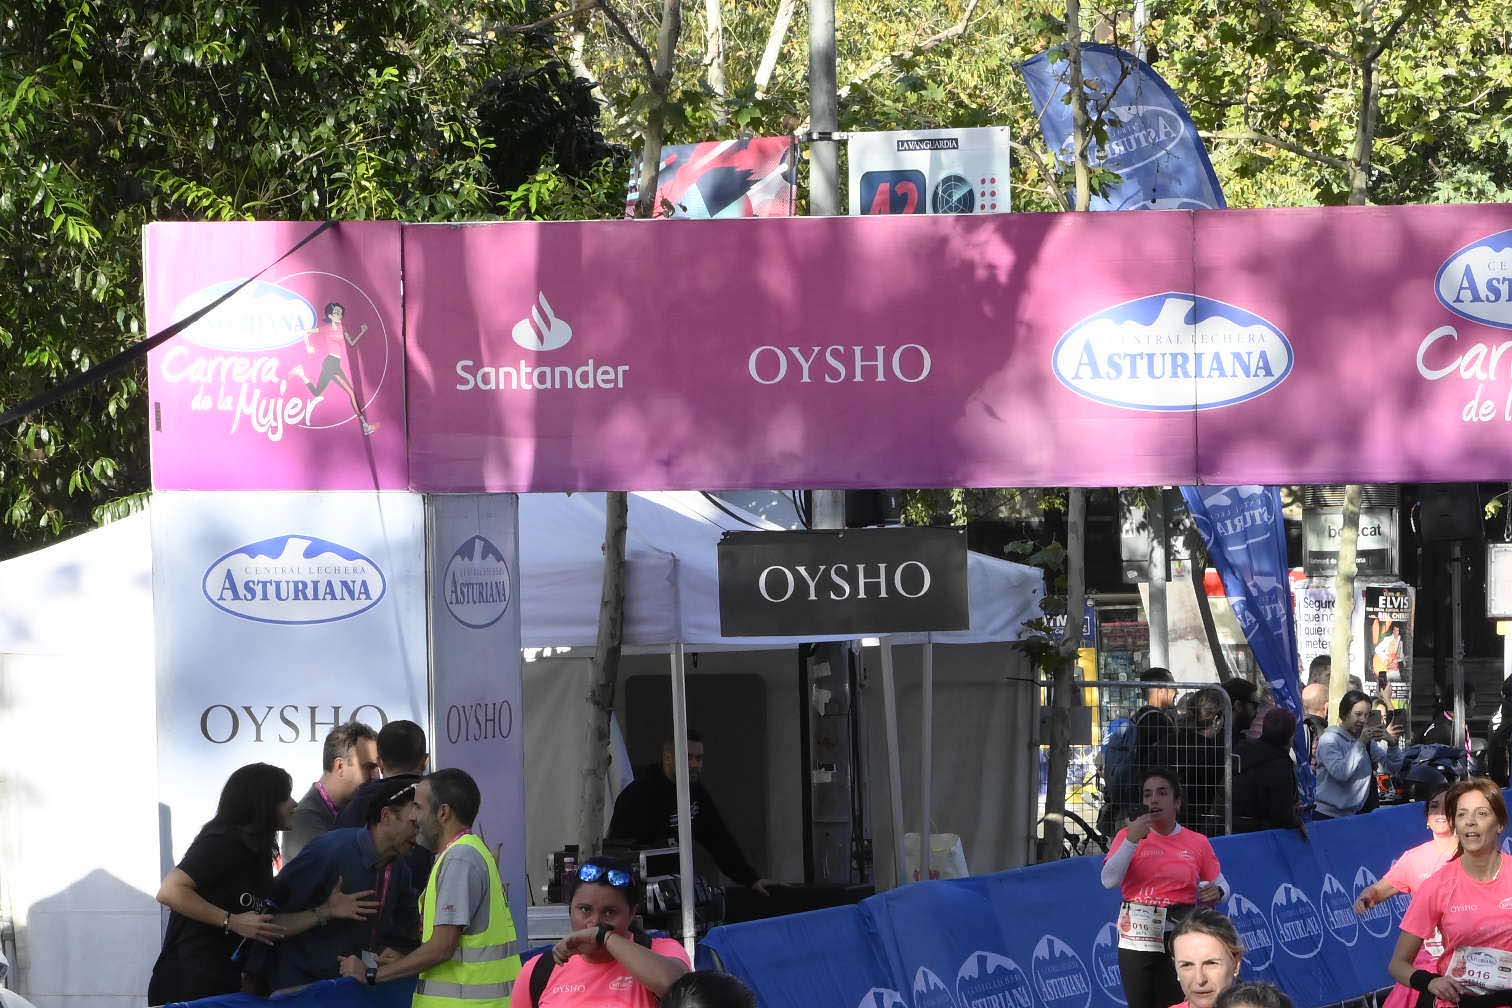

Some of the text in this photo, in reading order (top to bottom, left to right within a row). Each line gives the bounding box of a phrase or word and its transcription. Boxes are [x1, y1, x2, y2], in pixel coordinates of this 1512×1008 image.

[161, 345, 280, 383] Carrera
[456, 358, 630, 391] Santander
[748, 343, 932, 384] OYSHO
[1071, 338, 1275, 380] ASTURIANA
[231, 379, 325, 442] Mujer
[1463, 384, 1497, 423] de
[216, 568, 374, 601] ASTURIANA
[243, 565, 366, 576] CENTRAL LECHERA
[449, 570, 507, 606] ASTURIANA
[758, 560, 932, 604] OYSHO
[1378, 595, 1409, 610] ELVIS
[446, 700, 513, 744] OYSHO
